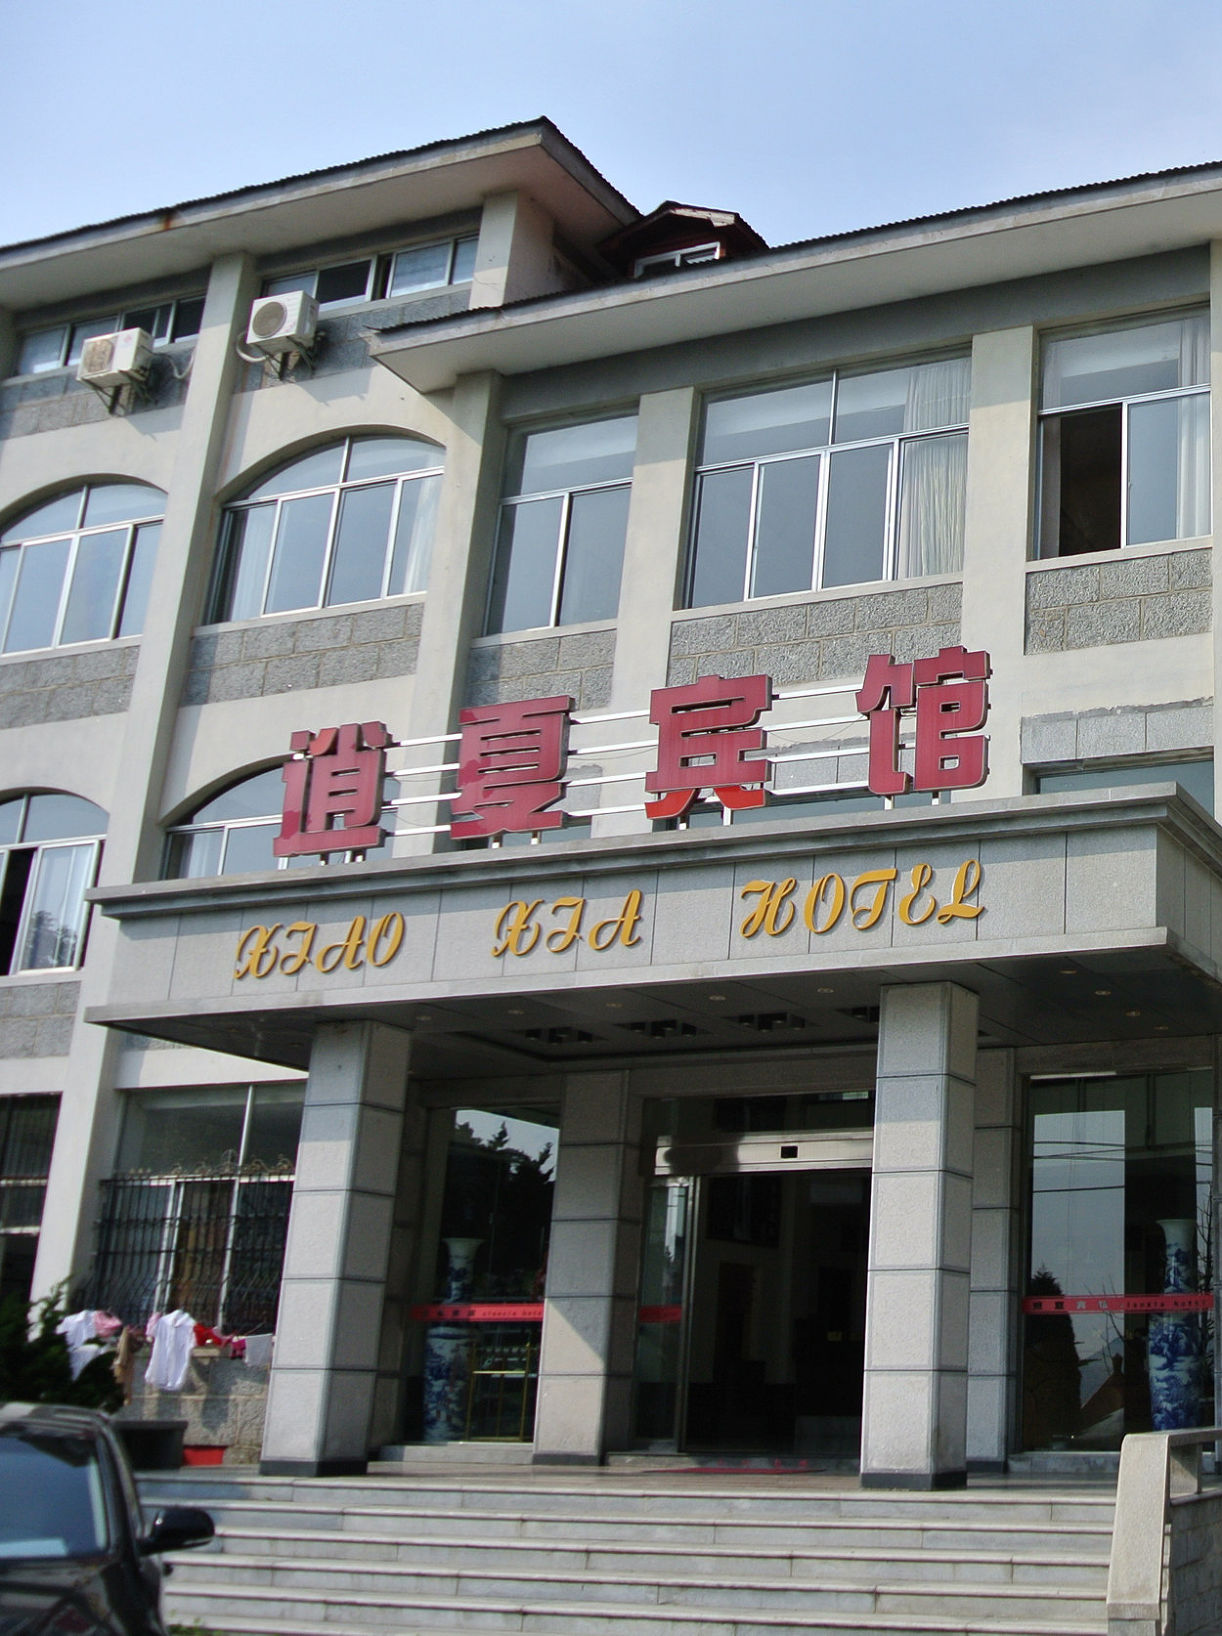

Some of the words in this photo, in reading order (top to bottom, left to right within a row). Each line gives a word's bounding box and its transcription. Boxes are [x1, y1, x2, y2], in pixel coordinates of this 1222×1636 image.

[273, 646, 993, 857] 逍夏宾馆
[233, 911, 406, 980] XIAO
[491, 889, 643, 957] XIA
[740, 859, 985, 937] HOTEL
